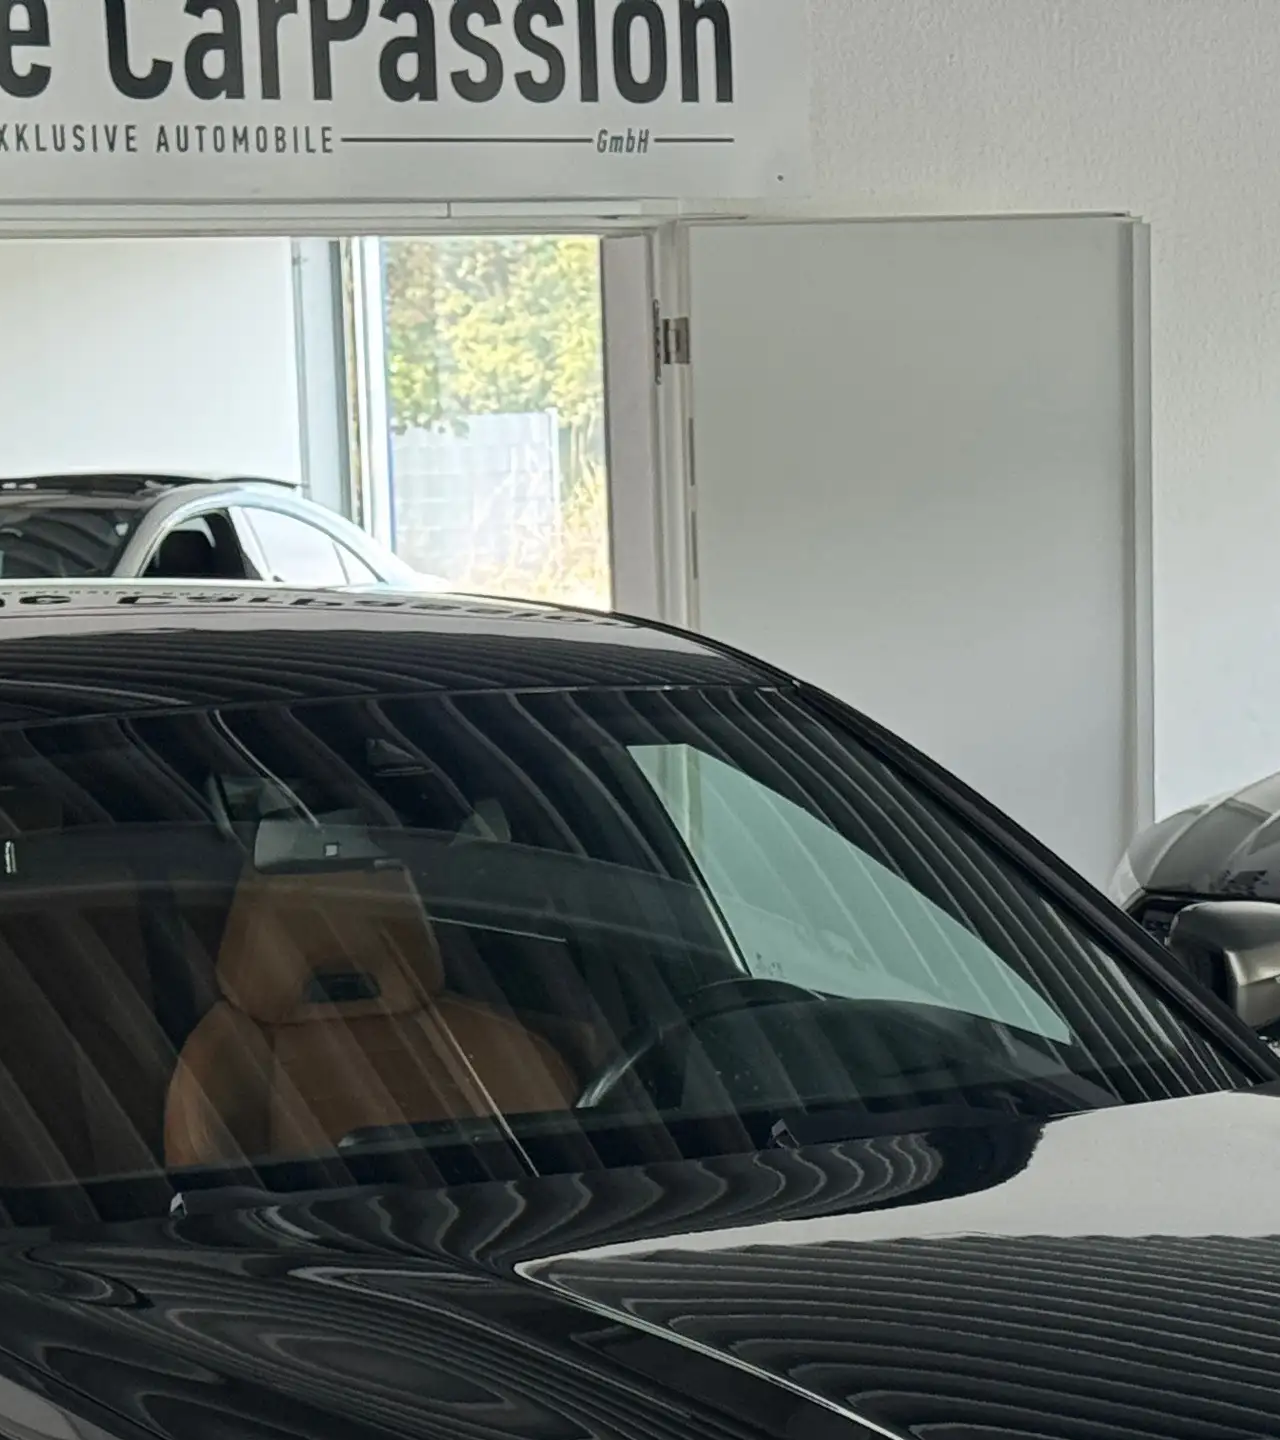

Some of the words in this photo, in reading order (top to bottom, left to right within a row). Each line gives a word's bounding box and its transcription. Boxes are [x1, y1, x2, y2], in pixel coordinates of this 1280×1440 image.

[106, 0, 734, 104] CarPassion
[156, 125, 333, 154] AUTOMOBILE
[596, 129, 650, 154] GmbH
